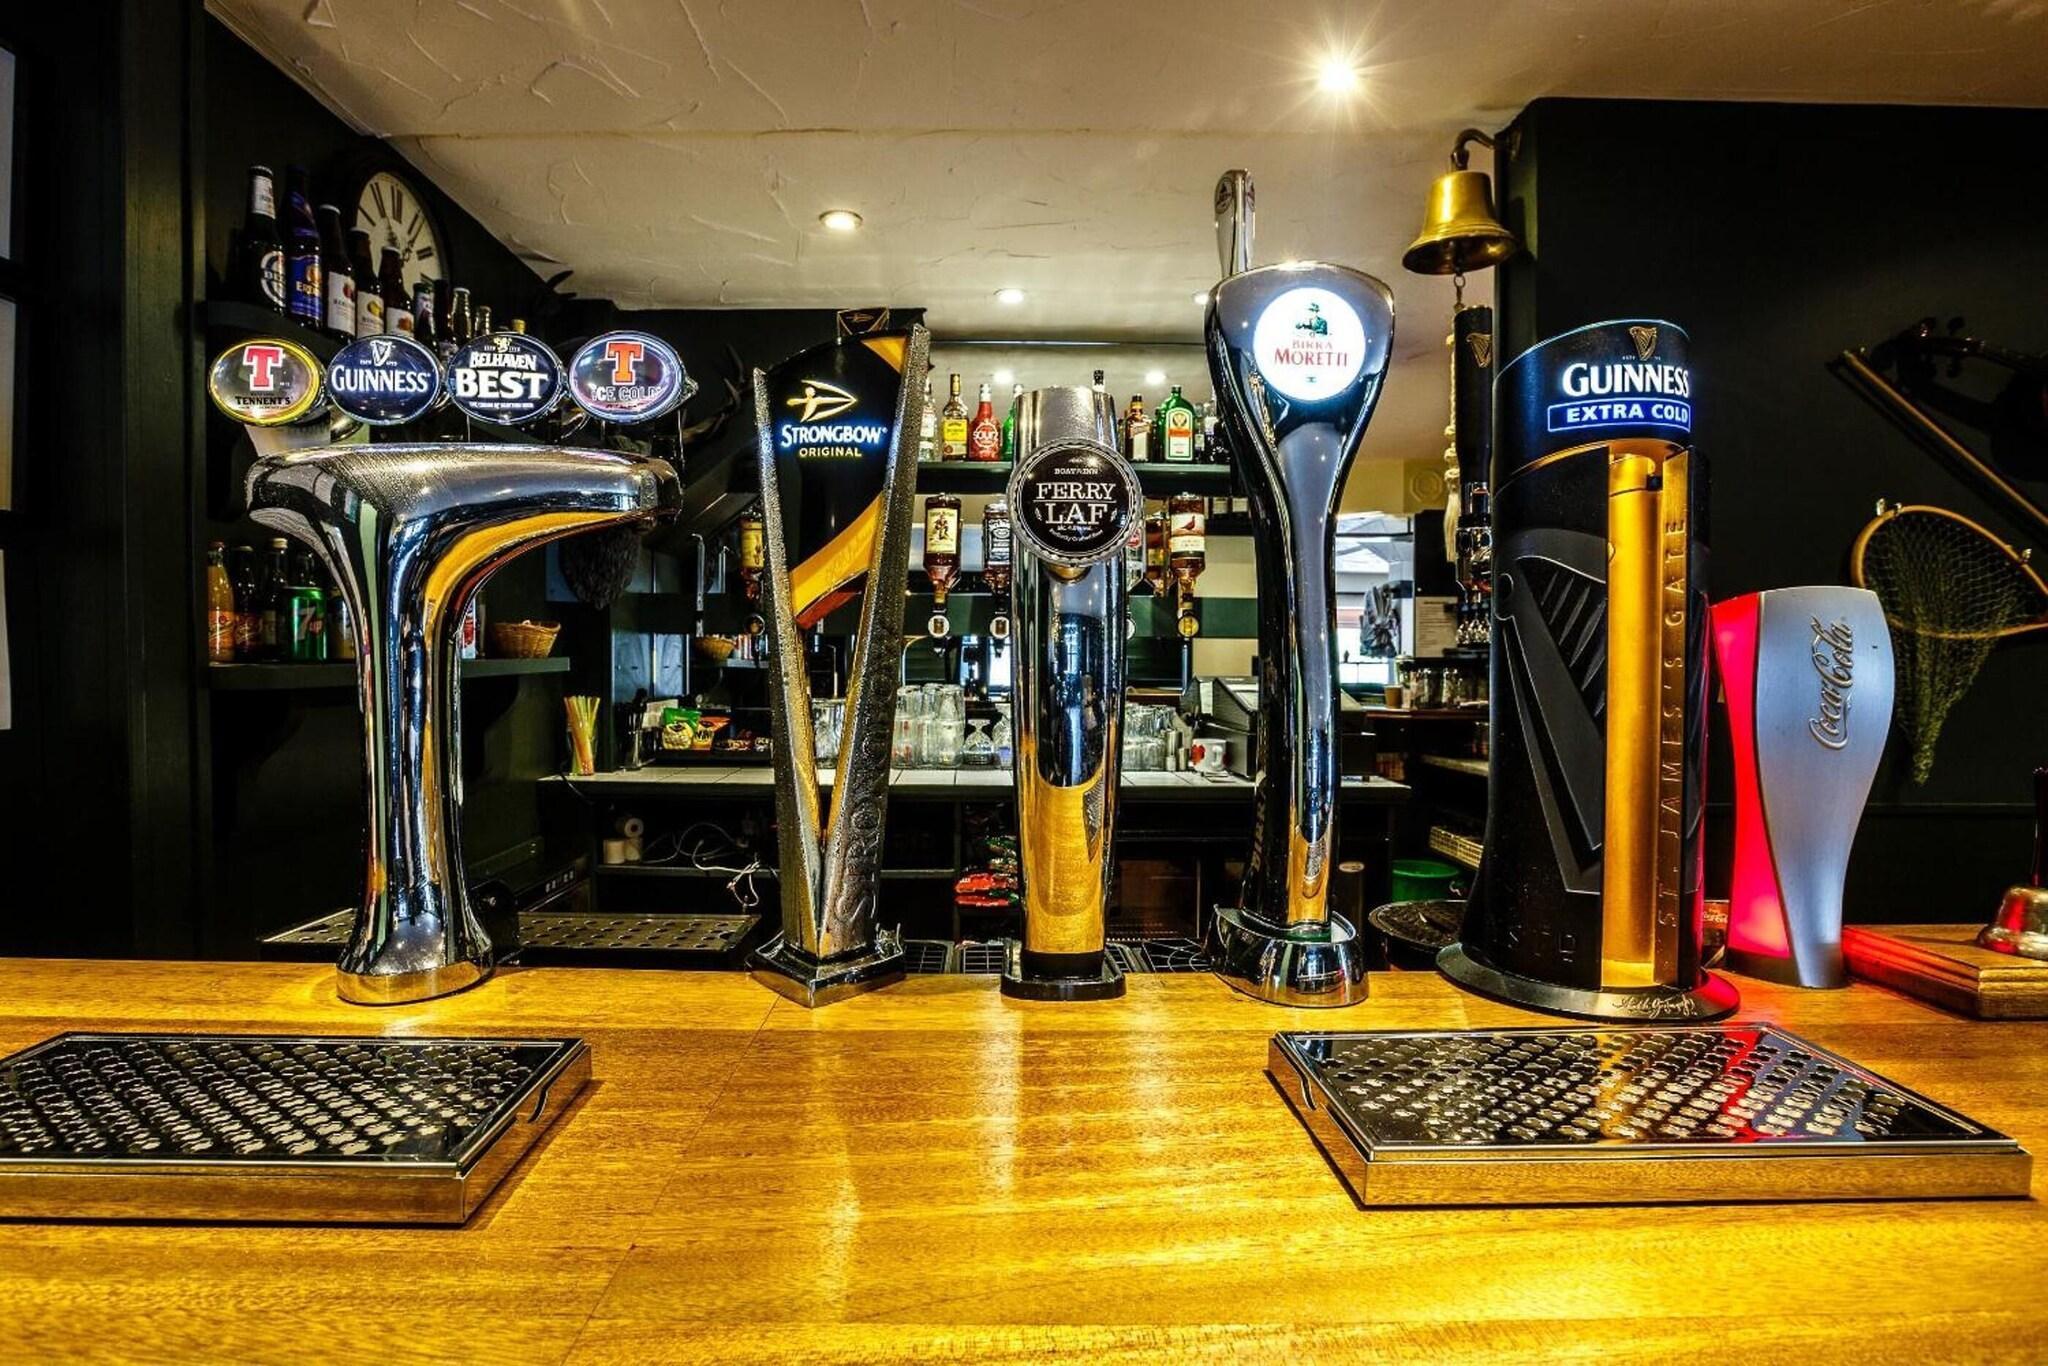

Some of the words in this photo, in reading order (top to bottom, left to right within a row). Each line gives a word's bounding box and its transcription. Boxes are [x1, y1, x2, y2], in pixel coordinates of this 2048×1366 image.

[243, 346, 283, 391] T
[469, 351, 536, 371] BELHAVEN
[605, 341, 644, 385] T
[1274, 347, 1348, 367] MORETTI
[331, 364, 429, 392] GUINNESS
[455, 368, 549, 399] BEST
[1562, 362, 1690, 398] GUINNESS
[1566, 403, 1645, 423] EXTRA
[1651, 404, 1689, 423] COLD
[780, 424, 882, 448] STRONGBOW
[799, 447, 862, 457] ORIGINAL
[1036, 482, 1116, 500] FERRY
[1045, 503, 1108, 525] LAF
[1664, 519, 1687, 628] GATE
